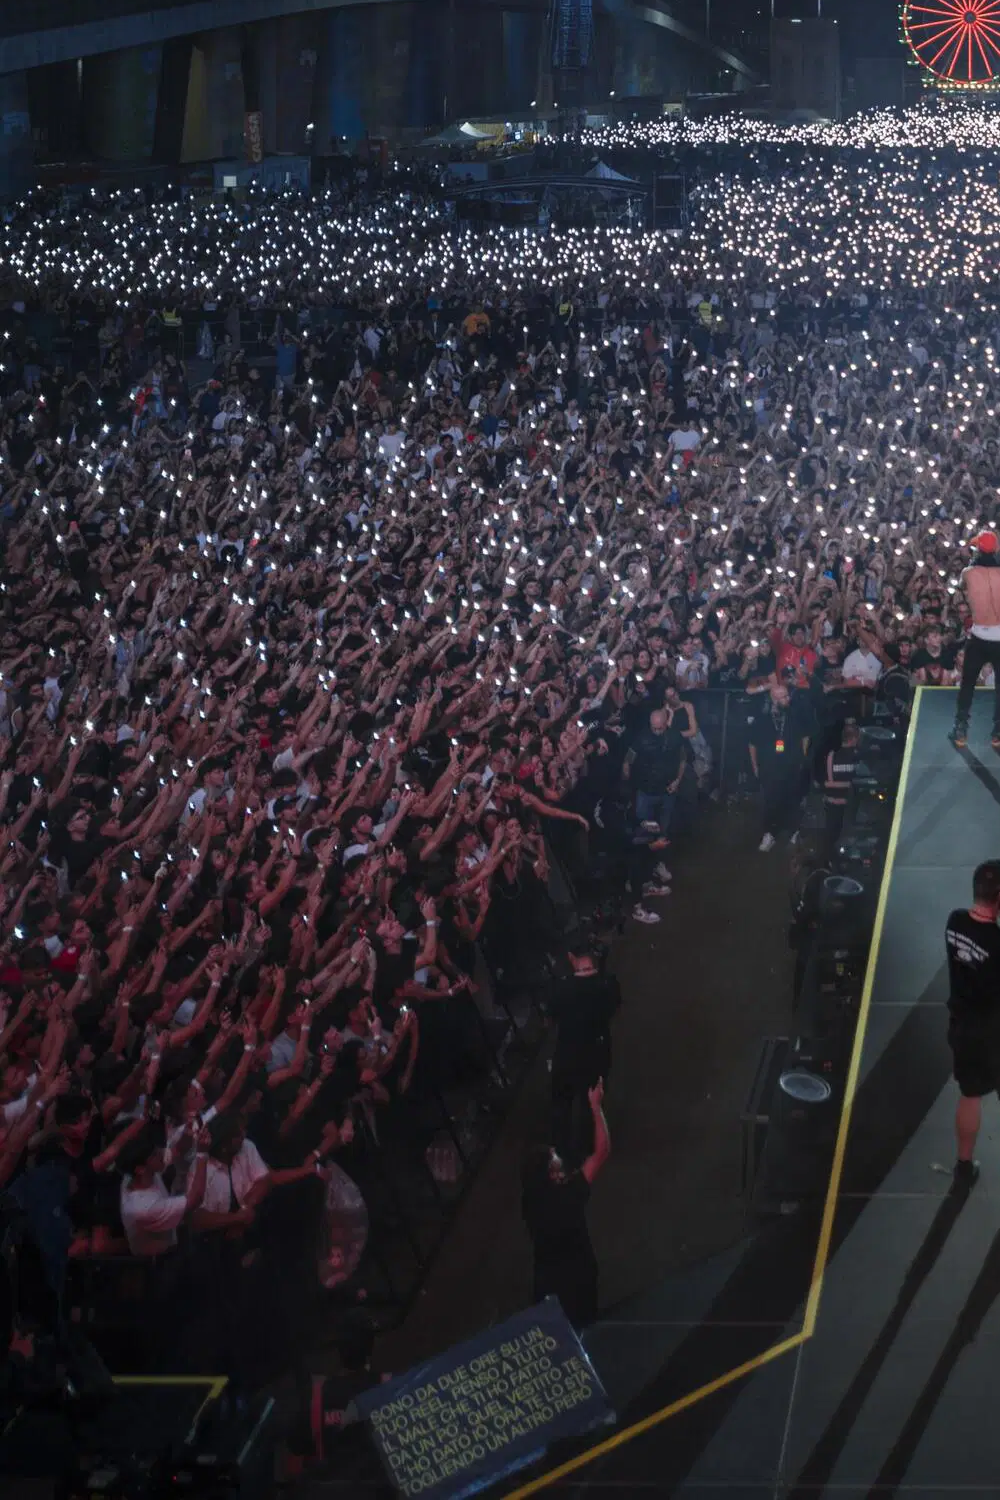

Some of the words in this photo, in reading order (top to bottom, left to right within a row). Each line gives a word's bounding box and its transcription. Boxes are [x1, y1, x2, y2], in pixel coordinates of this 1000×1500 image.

[370, 1394, 414, 1425] SONO
[415, 1383, 438, 1402] DA
[437, 1365, 469, 1391] DUE
[469, 1349, 500, 1373] ORE
[500, 1338, 521, 1358] SU
[520, 1326, 544, 1346] UN
[375, 1414, 408, 1438] TUO
[451, 1367, 500, 1400] PENSO
[510, 1336, 557, 1367] TUTTO
[382, 1439, 398, 1454] IL
[395, 1415, 439, 1446] MALE
[436, 1398, 471, 1424] CHE
[470, 1391, 487, 1406] TI
[486, 1378, 509, 1399] HO
[509, 1356, 552, 1387] FATTO
[388, 1448, 412, 1469] DA
[412, 1435, 436, 1456] UN
[464, 1400, 504, 1426] QUEL
[502, 1367, 562, 1404] VESTITO
[561, 1356, 583, 1373] TE
[432, 1431, 471, 1463] DATO
[491, 1405, 525, 1430] ORA
[522, 1393, 544, 1412] TE
[543, 1382, 564, 1402] LO
[564, 1369, 591, 1390] STA
[398, 1444, 485, 1496] TOGLIENDO
[484, 1429, 509, 1452] UN
[504, 1401, 554, 1440] ALTRO
